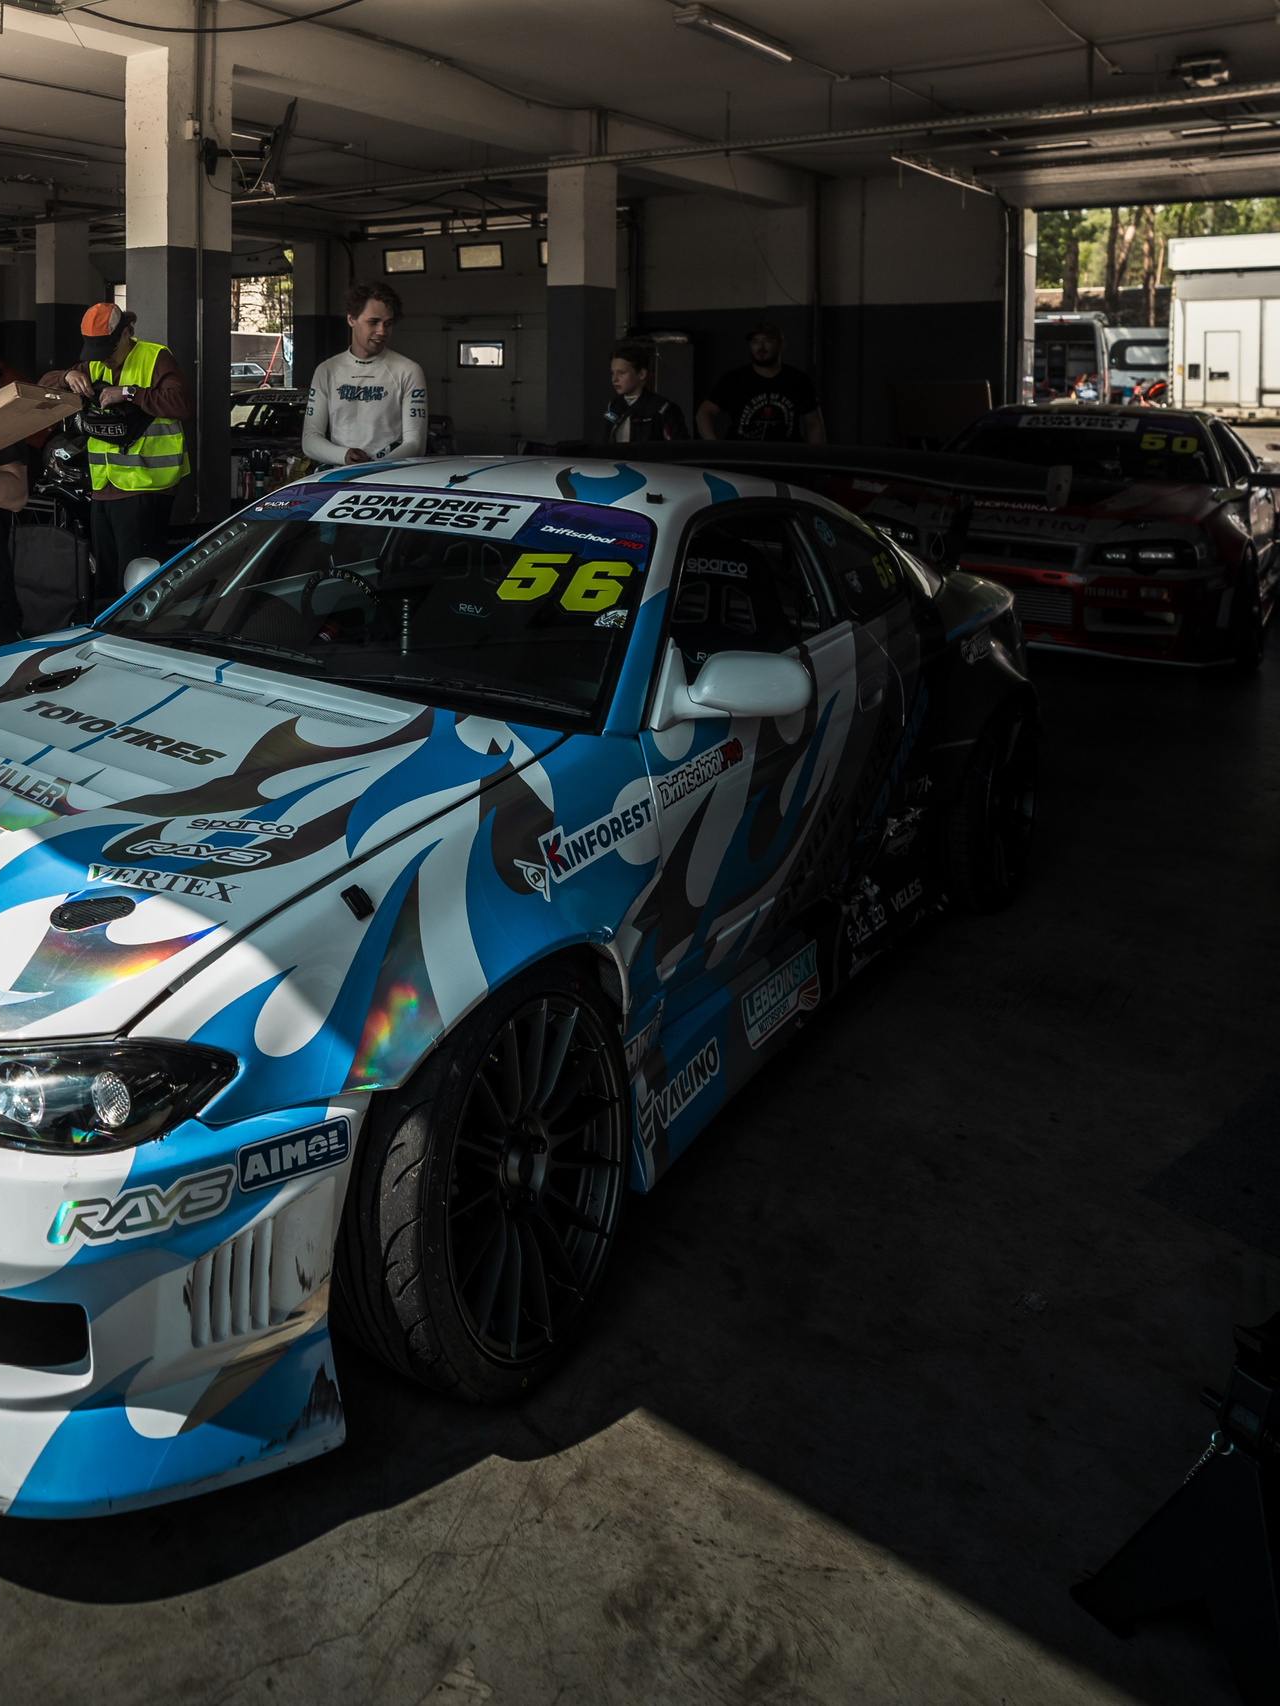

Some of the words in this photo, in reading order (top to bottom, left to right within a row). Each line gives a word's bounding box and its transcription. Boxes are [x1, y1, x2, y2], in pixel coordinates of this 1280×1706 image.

[410, 408, 426, 418] 313
[1140, 433, 1198, 454] 50
[327, 507, 510, 531] CONTEST
[338, 495, 415, 506] ADM
[415, 496, 521, 516] DRIFT
[496, 553, 634, 612] 56
[686, 557, 749, 577] sparco
[872, 551, 896, 590] 56
[458, 602, 484, 614] REV
[22, 699, 118, 738] TOYO
[116, 725, 230, 768] TIRES
[187, 818, 296, 838] sparco
[542, 798, 653, 878] KINFOREST
[128, 840, 270, 865] RAYS
[91, 865, 242, 903] VERTEX
[889, 878, 923, 912] VELES
[746, 949, 817, 1023] LEBEDINSKY
[758, 999, 790, 1035] MOTORSPORT
[654, 1040, 720, 1128] VALINO
[243, 1129, 347, 1184] AIMOL
[46, 1164, 235, 1245] RAYS
